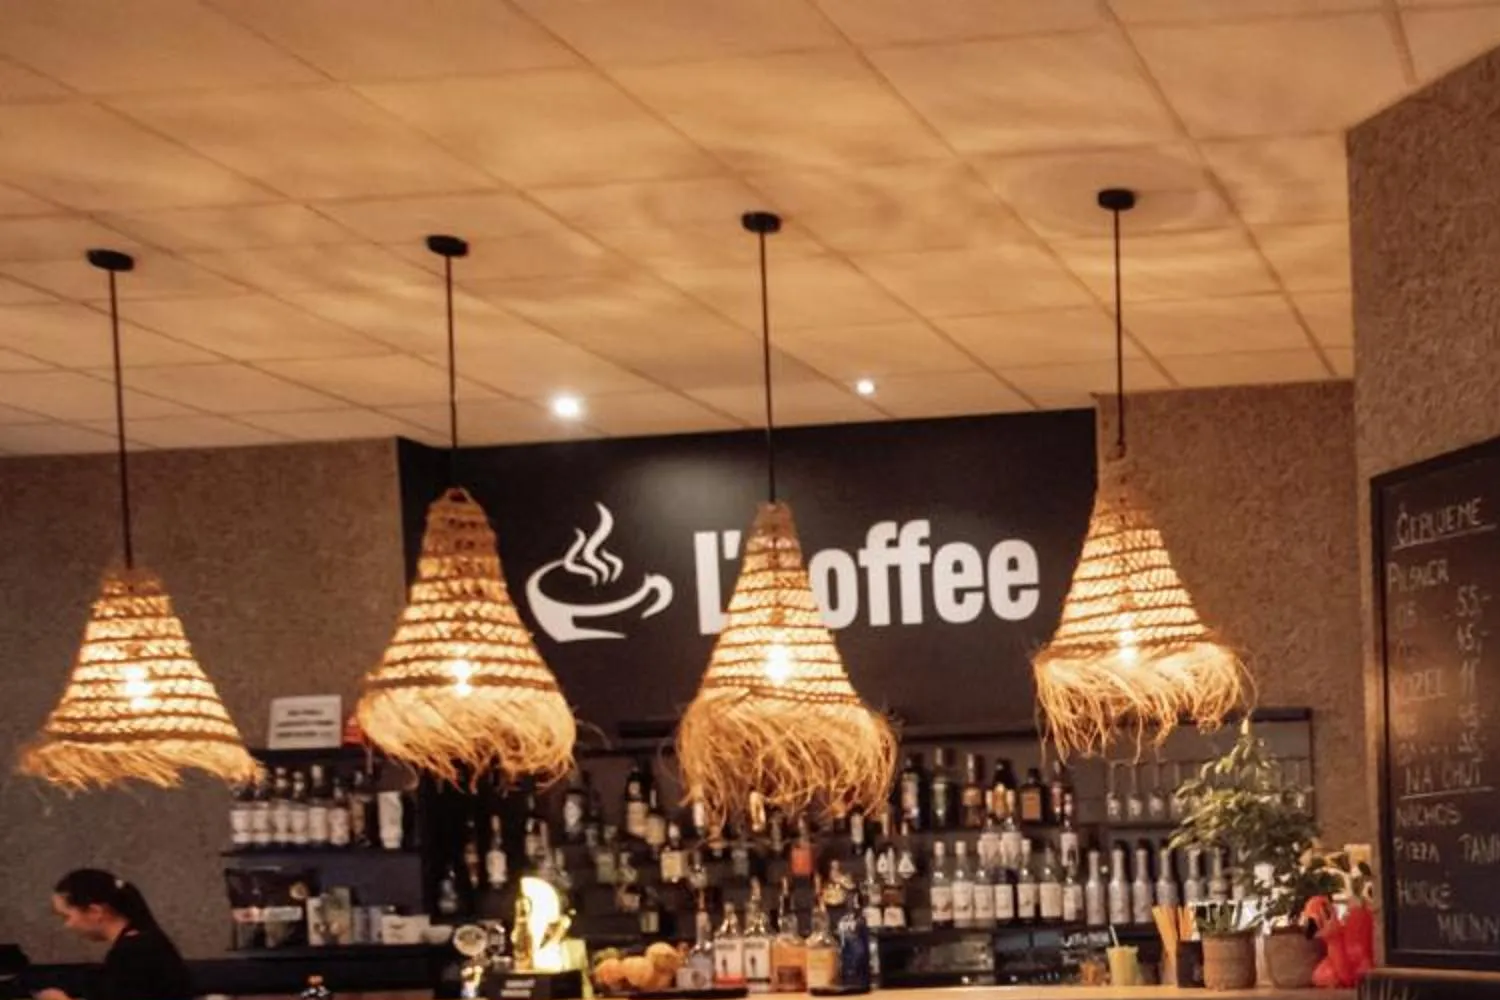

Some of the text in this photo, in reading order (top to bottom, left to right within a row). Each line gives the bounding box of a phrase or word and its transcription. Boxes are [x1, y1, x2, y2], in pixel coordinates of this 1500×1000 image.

[694, 519, 1041, 636] L'offee
[1396, 801, 1463, 829] NACHOS
[1393, 835, 1440, 864] PIZZA
